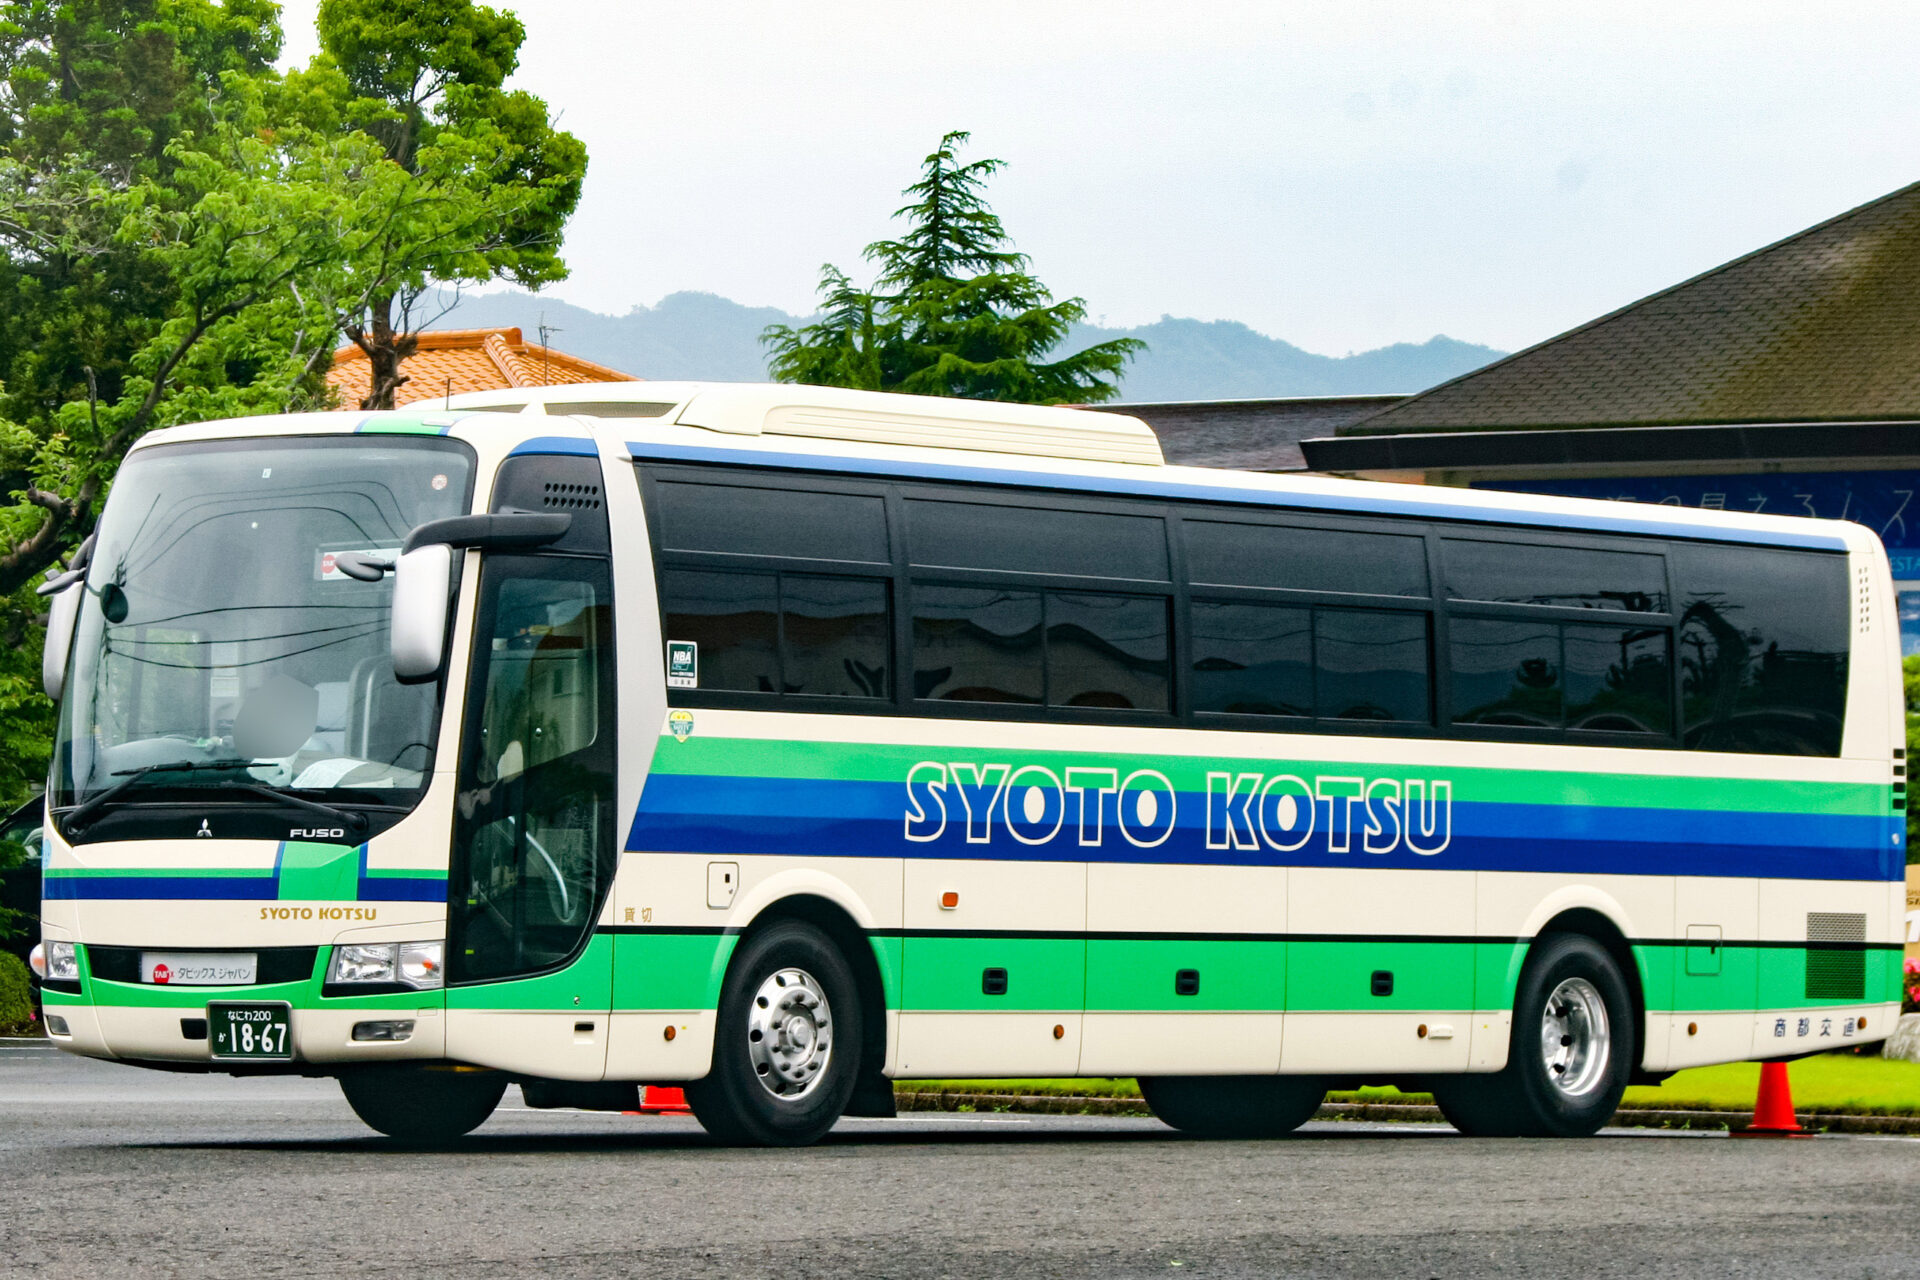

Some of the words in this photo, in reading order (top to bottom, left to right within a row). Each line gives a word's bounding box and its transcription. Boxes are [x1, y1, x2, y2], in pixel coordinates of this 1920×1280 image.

[673, 650, 692, 664] NBA
[904, 760, 1177, 848] SYOTO
[1205, 771, 1453, 856] KOTSU
[289, 828, 345, 838] FUSO
[260, 907, 313, 920] SYOTO
[318, 907, 377, 921] KOTSU
[1774, 1017, 1856, 1038] 商都交通
[230, 1023, 287, 1053] 18-67
